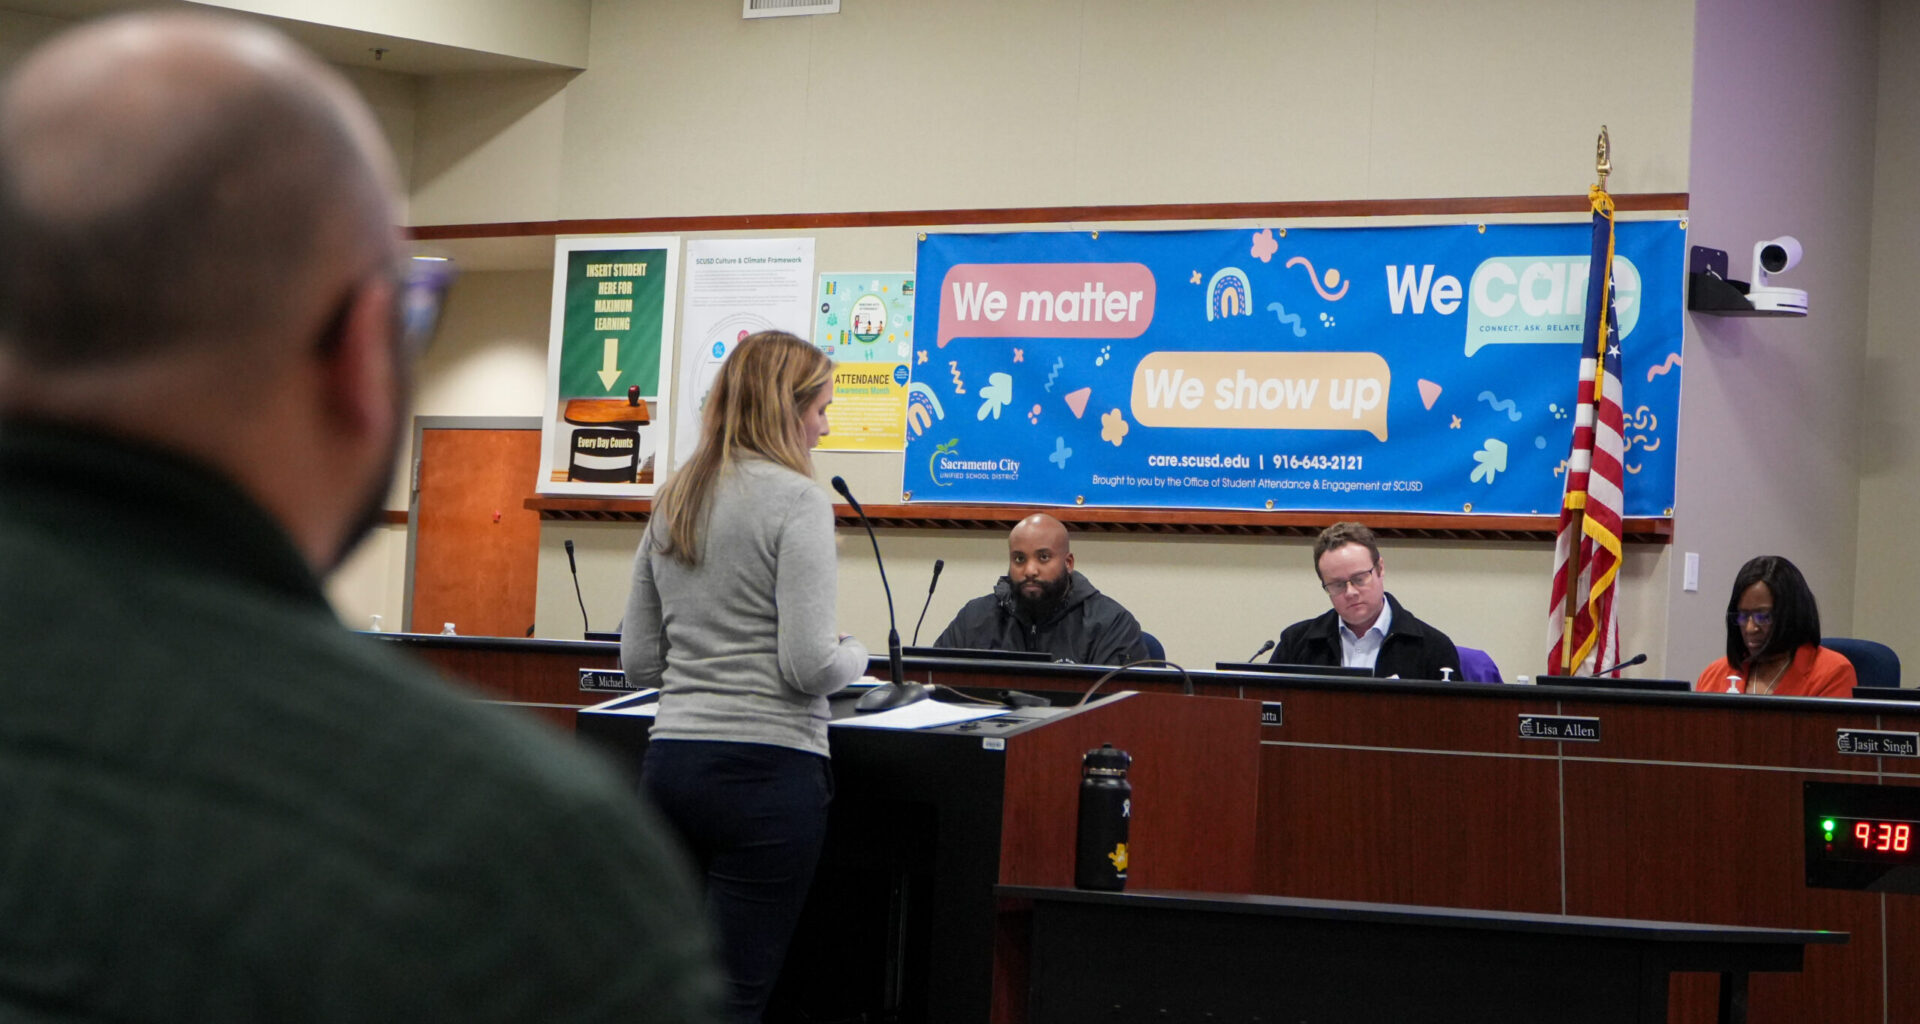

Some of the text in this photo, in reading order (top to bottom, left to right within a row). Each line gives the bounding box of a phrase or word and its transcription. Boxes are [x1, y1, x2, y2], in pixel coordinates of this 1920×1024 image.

[767, 256, 802, 264] Framework
[586, 262, 647, 277] INSERT STUDENT
[598, 281, 632, 295] HERE FOR
[1386, 261, 1637, 318] We care
[594, 299, 632, 313] MAXIMUM
[952, 281, 1144, 322] We matter
[594, 317, 631, 331] LEARNING
[834, 374, 890, 384] ATTENDANCE
[1144, 368, 1382, 420] We show up
[577, 436, 633, 450] Every Day Counts
[940, 457, 1020, 474] Sacramento City
[1148, 454, 1250, 468] care.scusd.edu
[1273, 455, 1363, 470] 916-643-2121
[991, 473, 1019, 481] DISTRICT
[1093, 475, 1423, 492] Brought to you by the Office of Student Attendance & Engagement at SCUSD
[599, 675, 624, 688] Michael
[1261, 712, 1277, 721] atta
[1536, 722, 1558, 735] Lisa
[1564, 723, 1595, 737] Allen
[1853, 737, 1879, 754] Jasjit
[1883, 738, 1913, 755] Singh
[1855, 822, 1911, 852] 9:38
